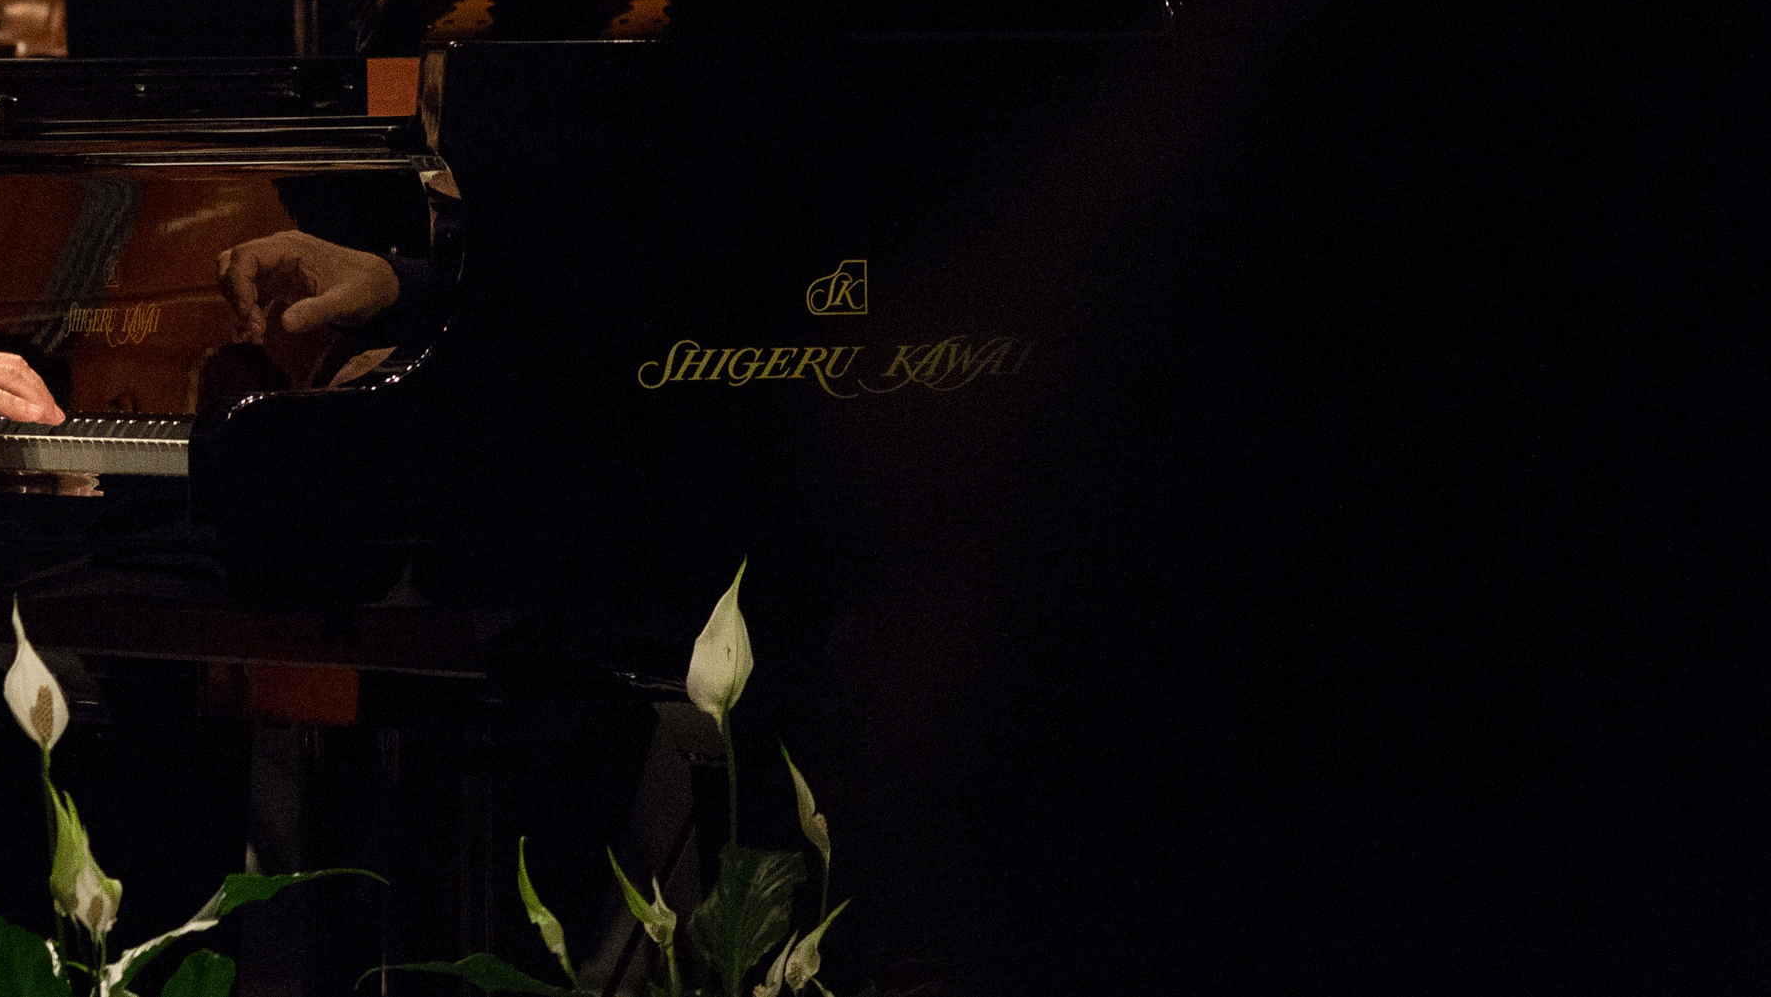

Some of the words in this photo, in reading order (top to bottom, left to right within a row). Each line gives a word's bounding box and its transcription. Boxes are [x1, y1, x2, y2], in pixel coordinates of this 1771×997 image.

[62, 301, 120, 348] SHIGERU
[116, 301, 162, 345] KAWAI
[638, 339, 866, 399] SHIGERU
[857, 334, 1034, 393] KAWAI
